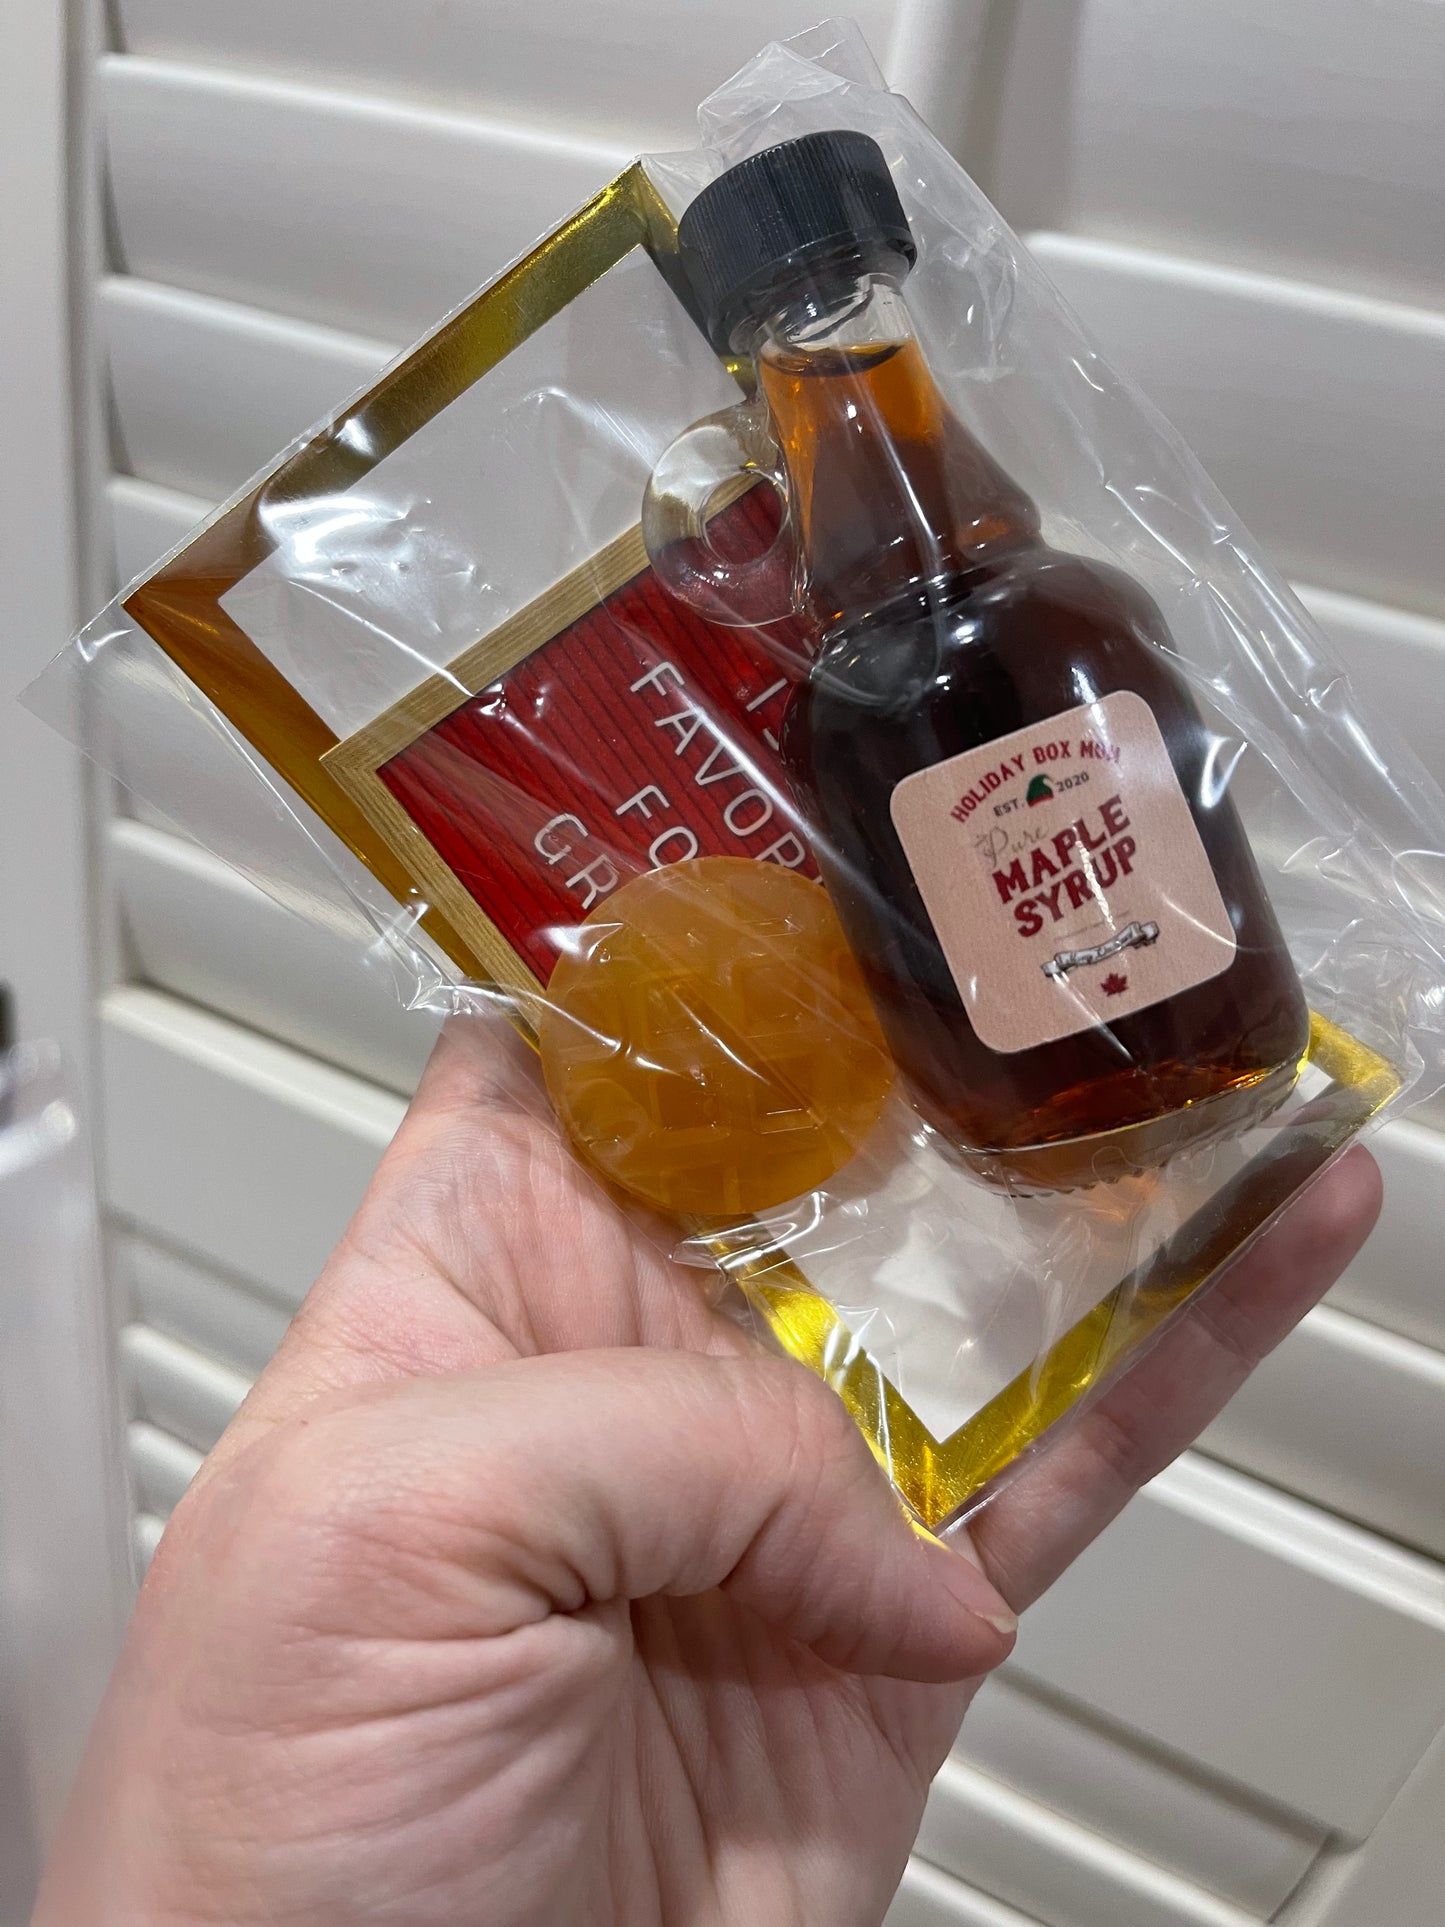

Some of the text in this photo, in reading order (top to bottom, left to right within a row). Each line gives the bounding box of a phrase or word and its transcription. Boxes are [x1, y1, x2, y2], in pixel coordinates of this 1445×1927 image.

[630, 661, 823, 884] FAVOR
[950, 754, 1025, 824] HOLIDAY
[1032, 740, 1071, 765] BOX
[1056, 771, 1090, 792] 2020
[976, 824, 1048, 868] Pure
[992, 794, 1131, 904] MAPLE
[1014, 836, 1136, 937] SYRUP
